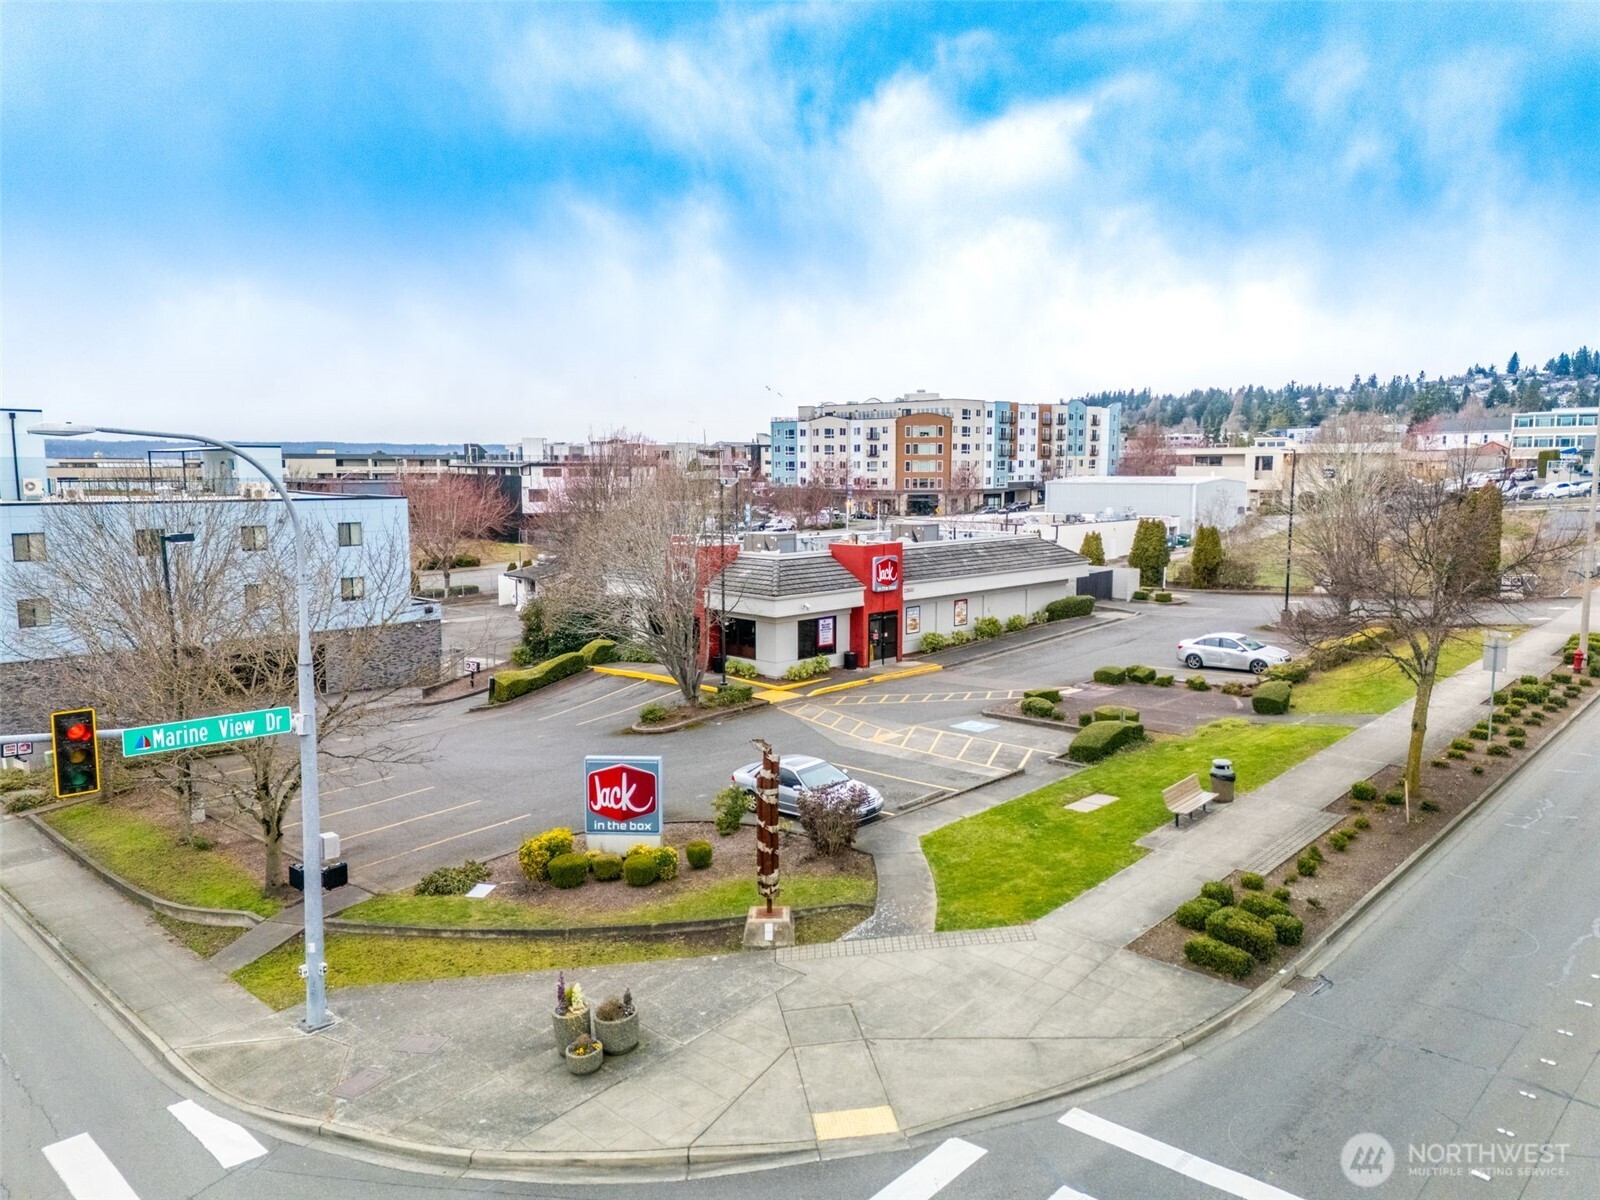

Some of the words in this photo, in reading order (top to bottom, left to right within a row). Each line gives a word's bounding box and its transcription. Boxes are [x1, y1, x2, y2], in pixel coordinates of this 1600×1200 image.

[877, 561, 898, 582] Jack
[152, 726, 209, 748] Marine
[218, 718, 255, 739] View
[265, 712, 283, 732] Dr
[590, 772, 653, 812] Jack
[593, 820, 605, 830] in
[607, 821, 627, 830] the
[629, 821, 653, 830] box
